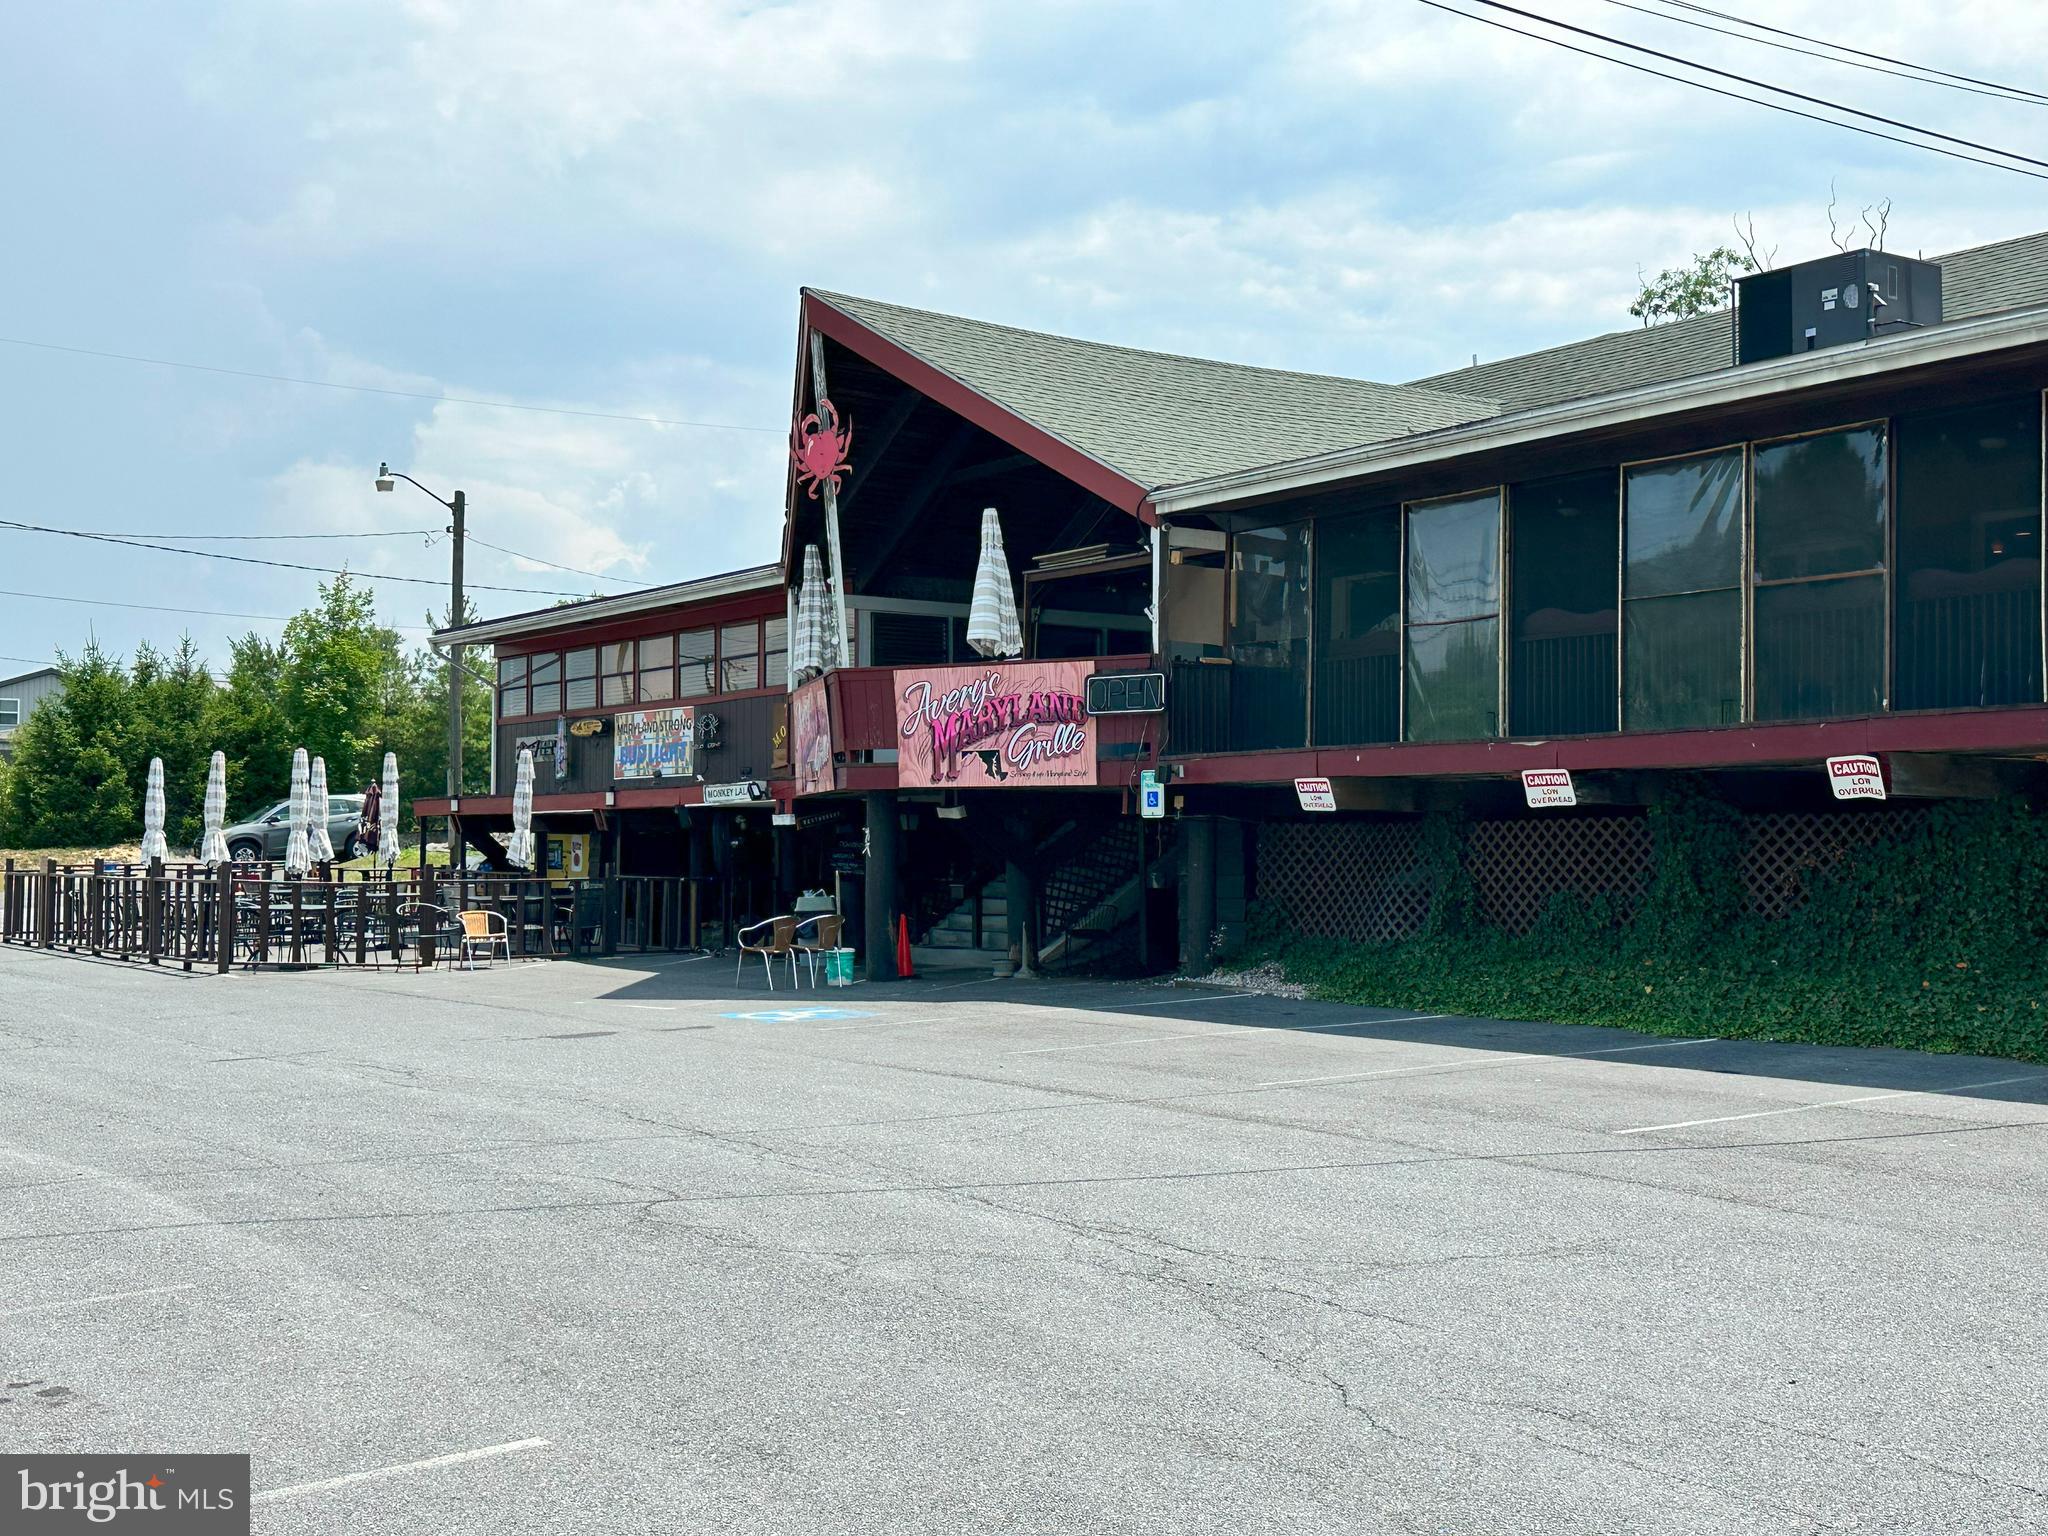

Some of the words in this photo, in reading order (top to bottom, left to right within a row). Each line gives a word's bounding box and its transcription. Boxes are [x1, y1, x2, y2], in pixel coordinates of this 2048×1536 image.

[1090, 677, 1161, 711] OPEN
[903, 669, 1000, 736] Avery's
[617, 720, 658, 736] MARYLAND
[660, 717, 692, 732] STRONG
[930, 691, 1088, 784] MARYLAND
[1007, 722, 1087, 771] Grille
[1833, 762, 1878, 775] CAUTION
[1298, 782, 1329, 792] CAUTION
[1527, 774, 1568, 786] CAUTION
[707, 788, 734, 798] MONKEY
[1530, 796, 1573, 804] OVERHEAD
